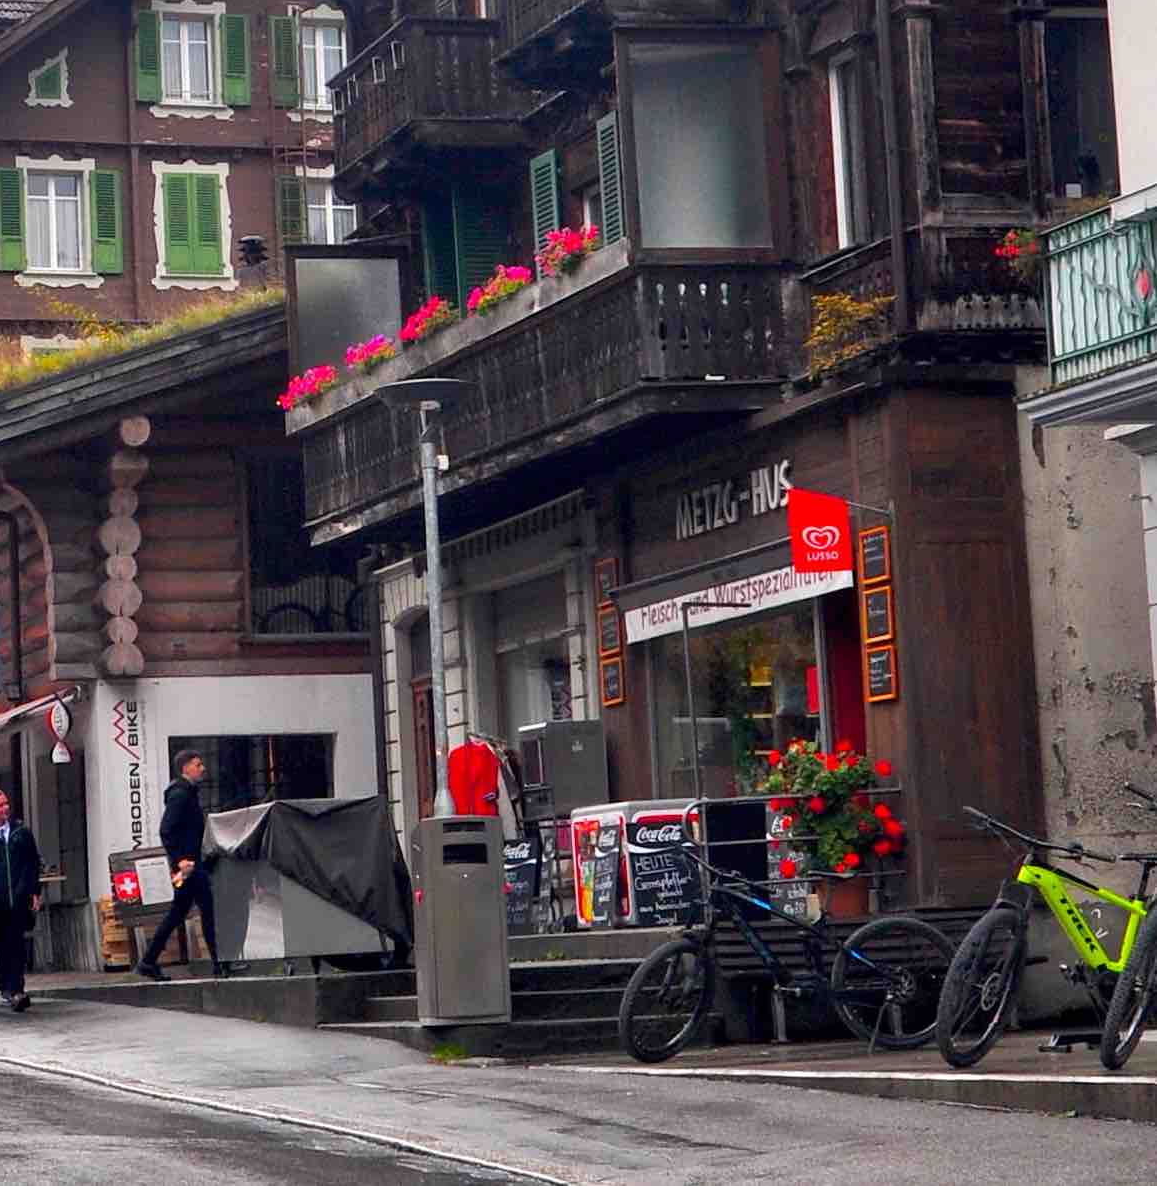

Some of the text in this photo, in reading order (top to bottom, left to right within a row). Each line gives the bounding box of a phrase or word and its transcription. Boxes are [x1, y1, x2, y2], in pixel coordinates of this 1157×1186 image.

[806, 551, 839, 562] LUSSO
[126, 701, 139, 747] BIKE
[635, 854, 675, 872] HEUTE
